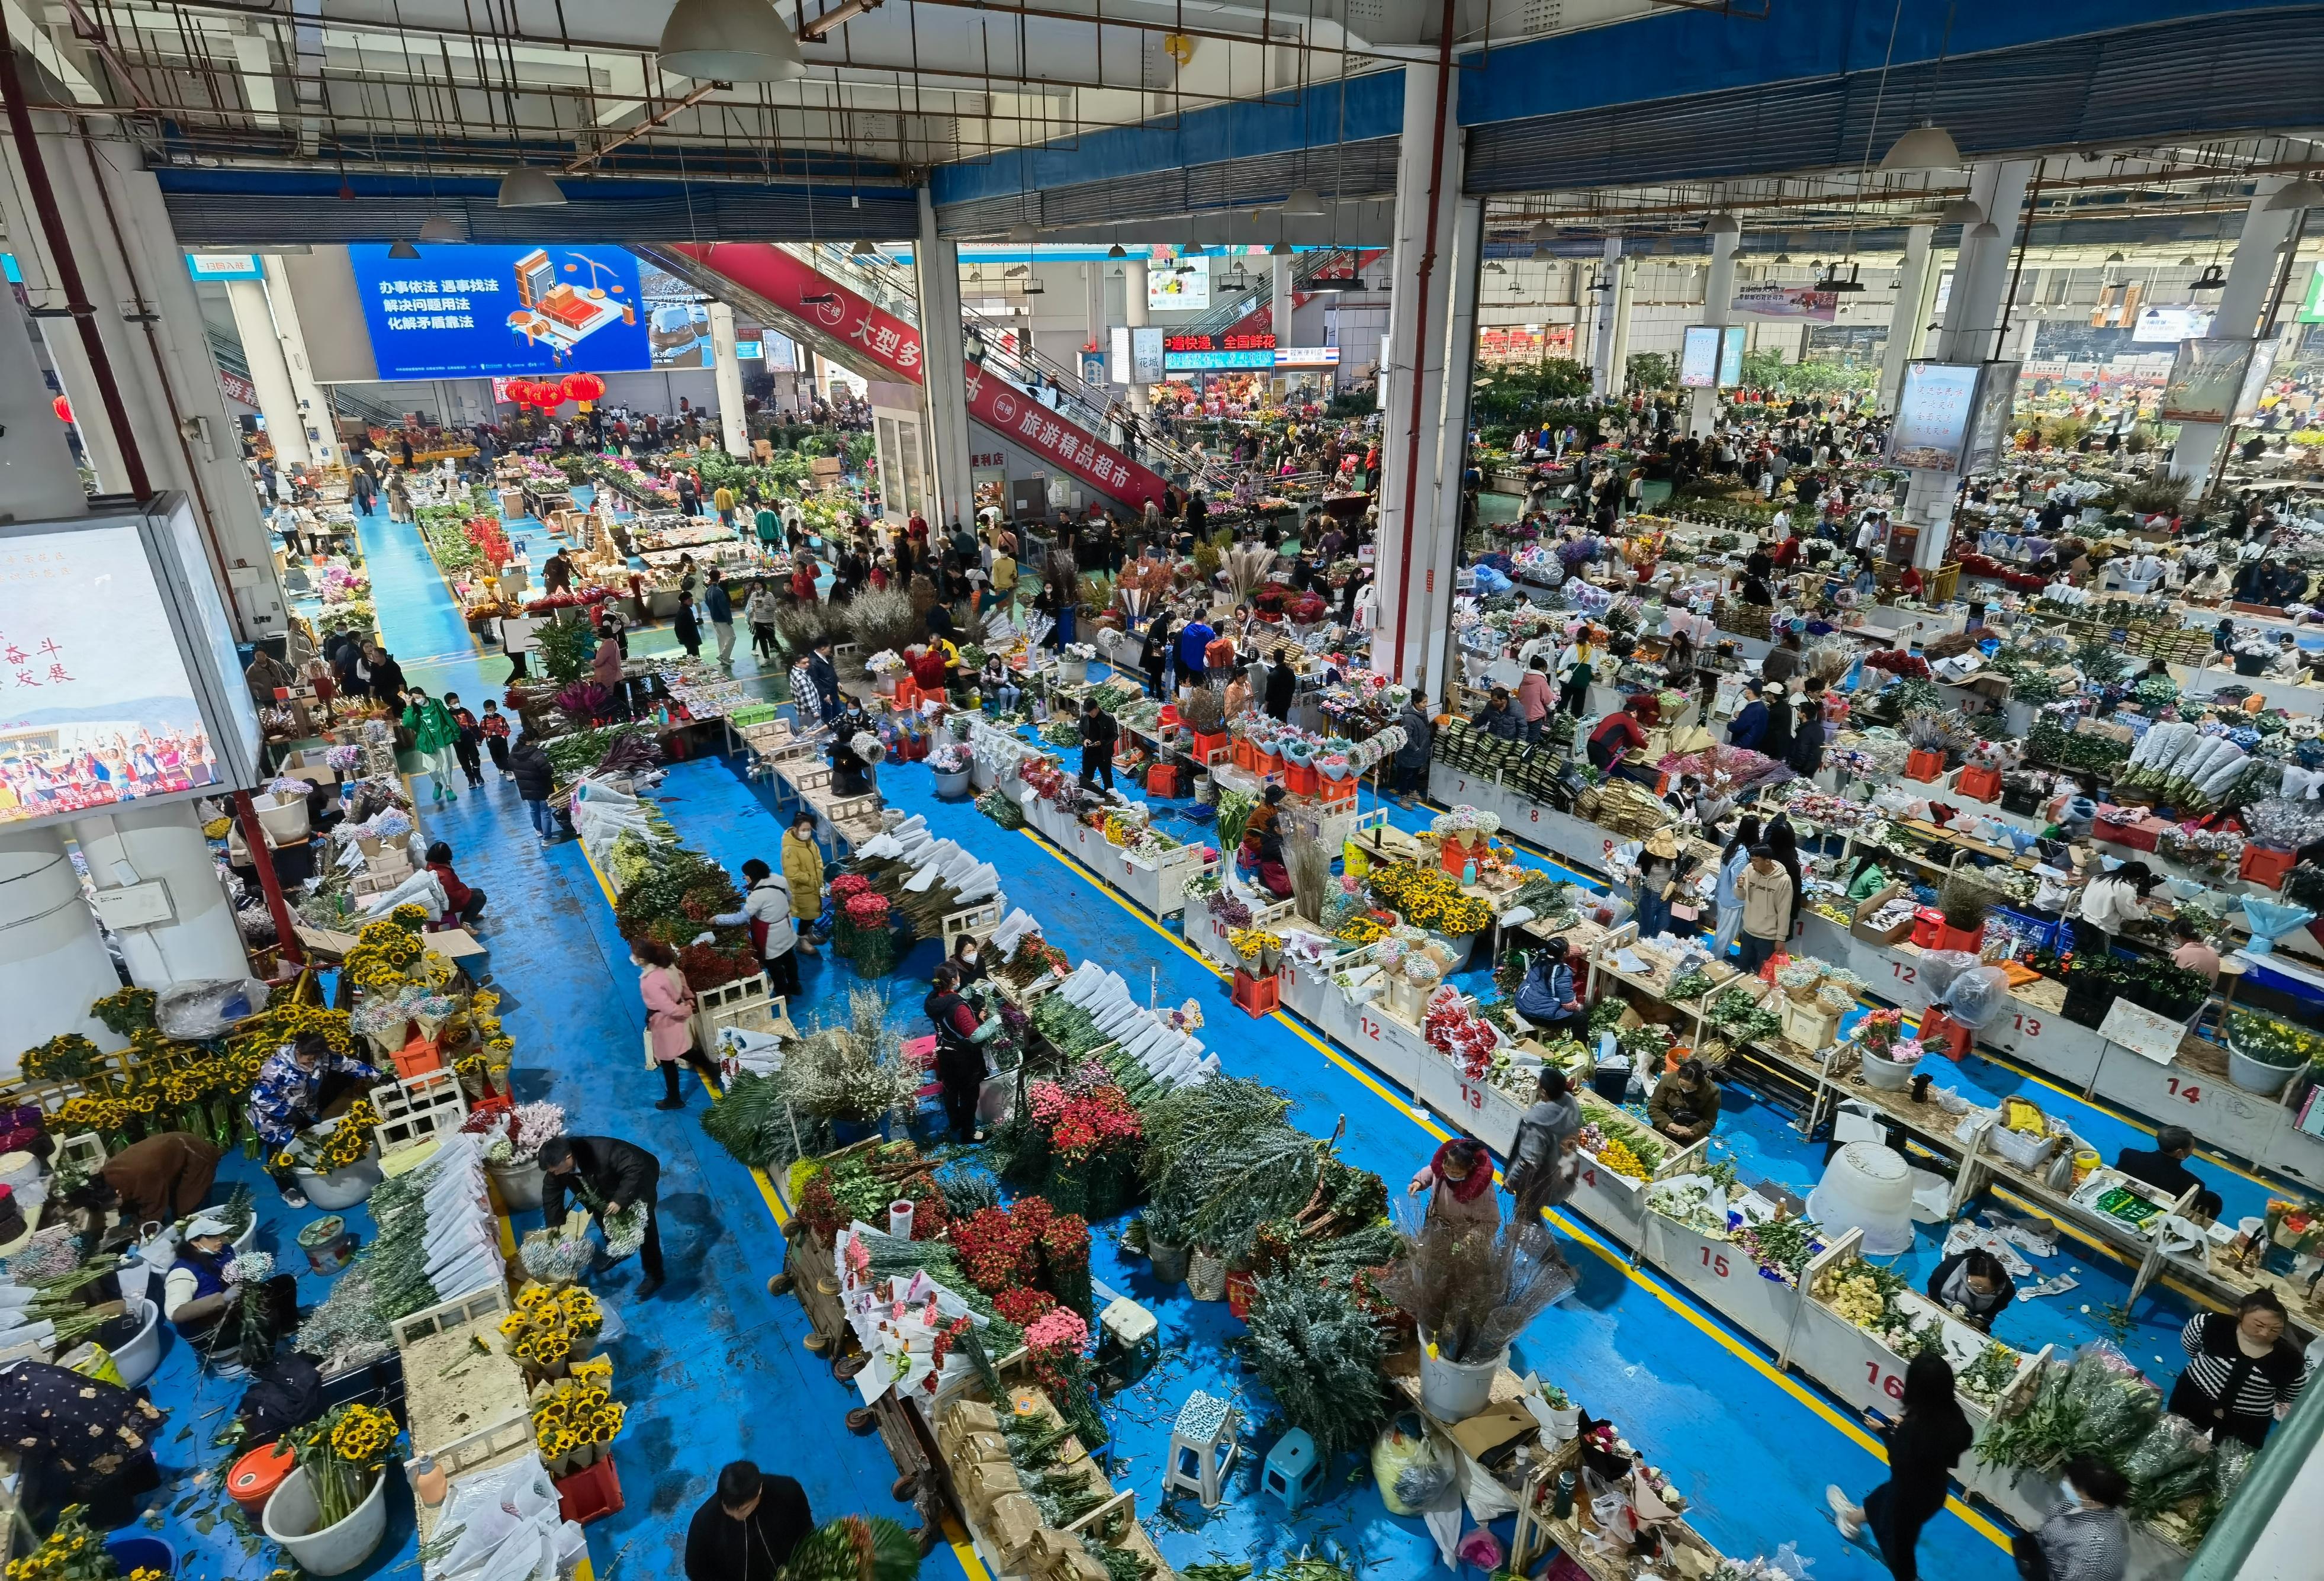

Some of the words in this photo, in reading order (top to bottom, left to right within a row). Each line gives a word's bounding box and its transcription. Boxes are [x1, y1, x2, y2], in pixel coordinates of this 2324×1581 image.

[379, 280, 438, 294] 办事依法
[441, 278, 499, 293] 遇事找法
[383, 297, 471, 312] 解决问题用法
[388, 315, 474, 330] 化解矛盾靠法
[1139, 344, 1158, 355] 斗南
[1139, 356, 1159, 368] 花城
[997, 400, 1012, 416] 四楼
[1018, 410, 1131, 488] 旅游精品超市
[3, 637, 63, 664] 奋斗
[15, 663, 77, 687] 发展
[1458, 780, 1465, 792] 7
[1531, 809, 1538, 822] 8
[1079, 830, 1085, 843] 8
[1603, 840, 1612, 853] 9
[1126, 862, 1132, 875] 9
[1280, 964, 1294, 985] 11
[1892, 962, 1916, 984] 12
[1361, 1017, 1380, 1042] 12
[2014, 1014, 2041, 1036] 13
[1460, 1084, 1481, 1109] 13
[2167, 1078, 2200, 1103] 14
[1701, 1246, 1730, 1277] 15
[1866, 1361, 1905, 1400] 16
